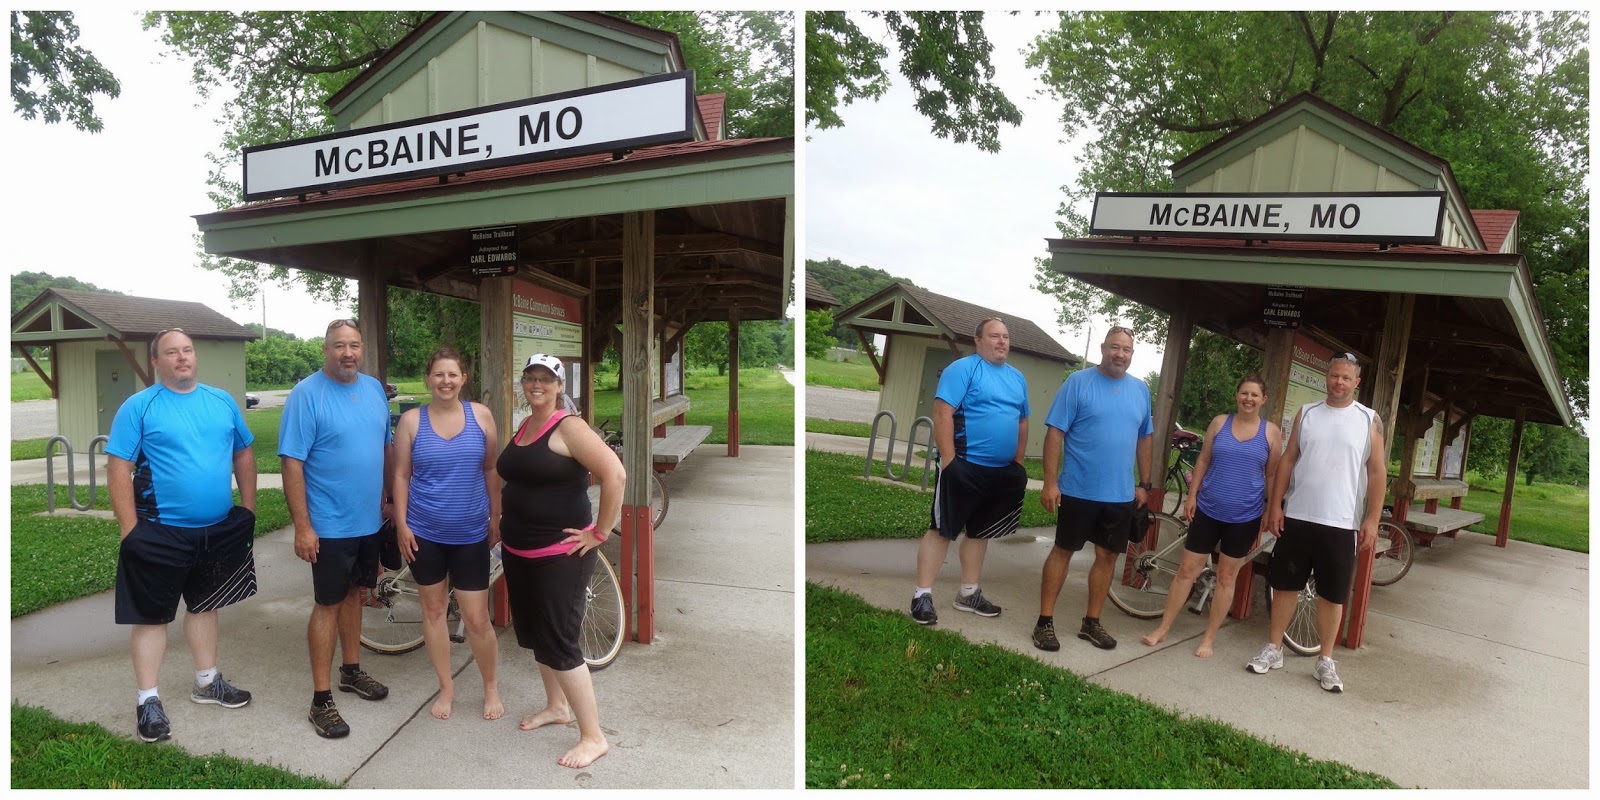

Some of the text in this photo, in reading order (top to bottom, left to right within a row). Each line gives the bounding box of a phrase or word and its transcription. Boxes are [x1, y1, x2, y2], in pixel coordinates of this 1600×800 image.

[519, 106, 583, 147] MO
[1309, 203, 1361, 229] MO
[472, 230, 515, 240] McBaine Trailhead
[470, 252, 517, 264] CARL EDWARDS
[529, 298, 551, 314] Community
[551, 303, 566, 318] Services
[1263, 308, 1301, 318] CARL EDWARDS
